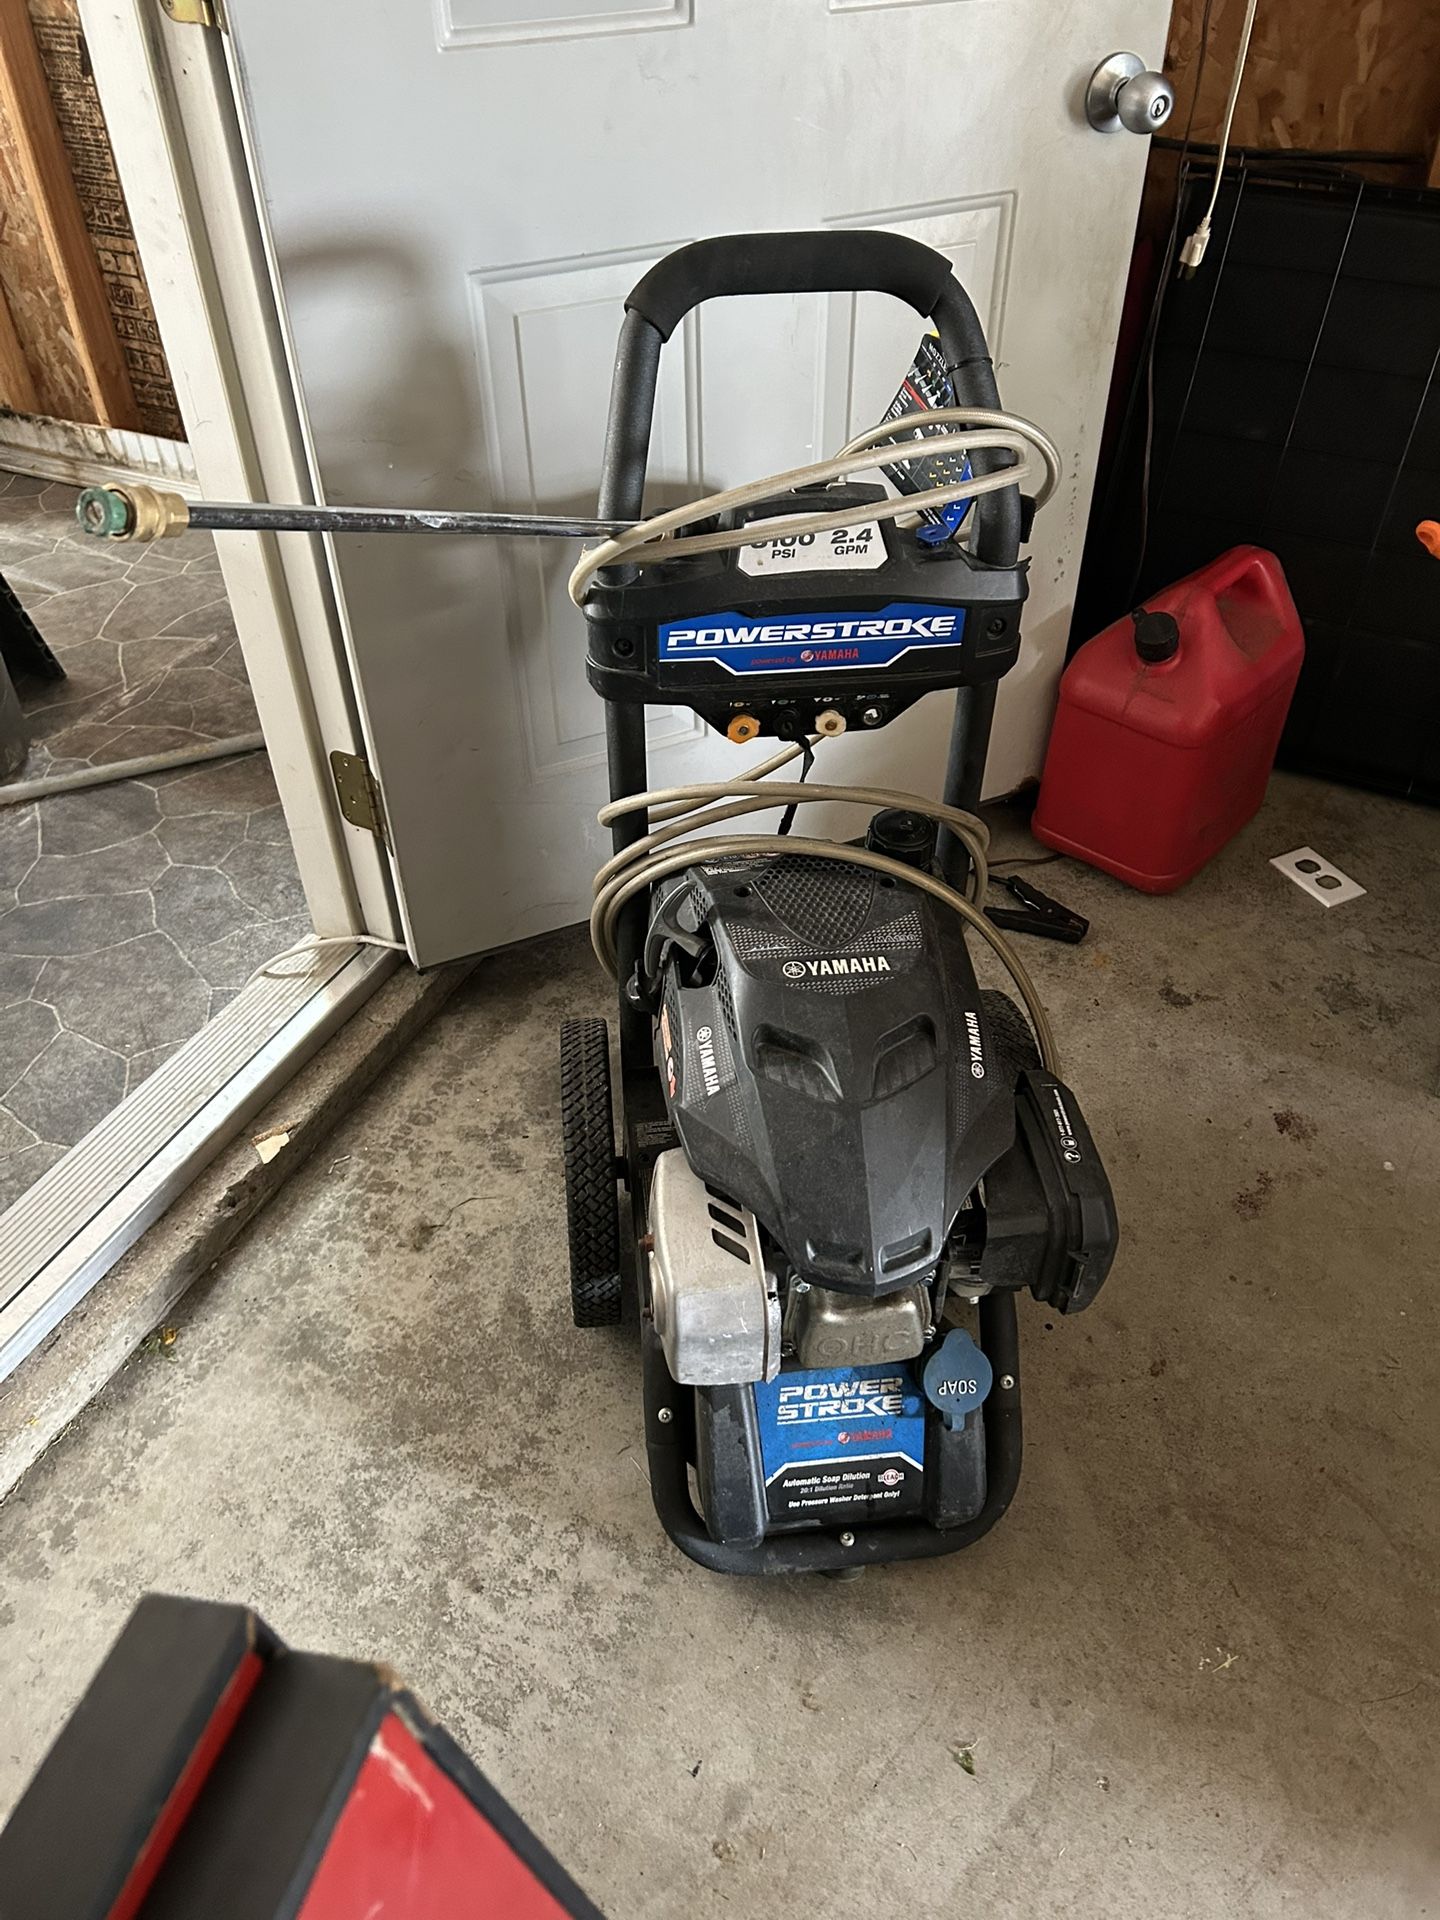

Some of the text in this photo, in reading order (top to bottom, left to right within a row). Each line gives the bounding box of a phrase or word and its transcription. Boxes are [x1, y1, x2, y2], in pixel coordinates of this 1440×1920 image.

[830, 528, 873, 544] 2.4
[771, 544, 868, 559] PSI GPM
[667, 615, 956, 646] POWERSTROKE
[814, 648, 859, 660] YAMAHA
[806, 956, 891, 976] YAMAHA
[964, 1011, 983, 1061] YAMAHA
[699, 1039, 720, 1097] YAMAHA
[817, 1331, 911, 1356] OHC
[779, 1377, 904, 1402] POWER
[938, 1379, 977, 1396] SOAP
[777, 1394, 903, 1420] STROKE
[782, 1472, 871, 1488] Automatic Soap Dilution
